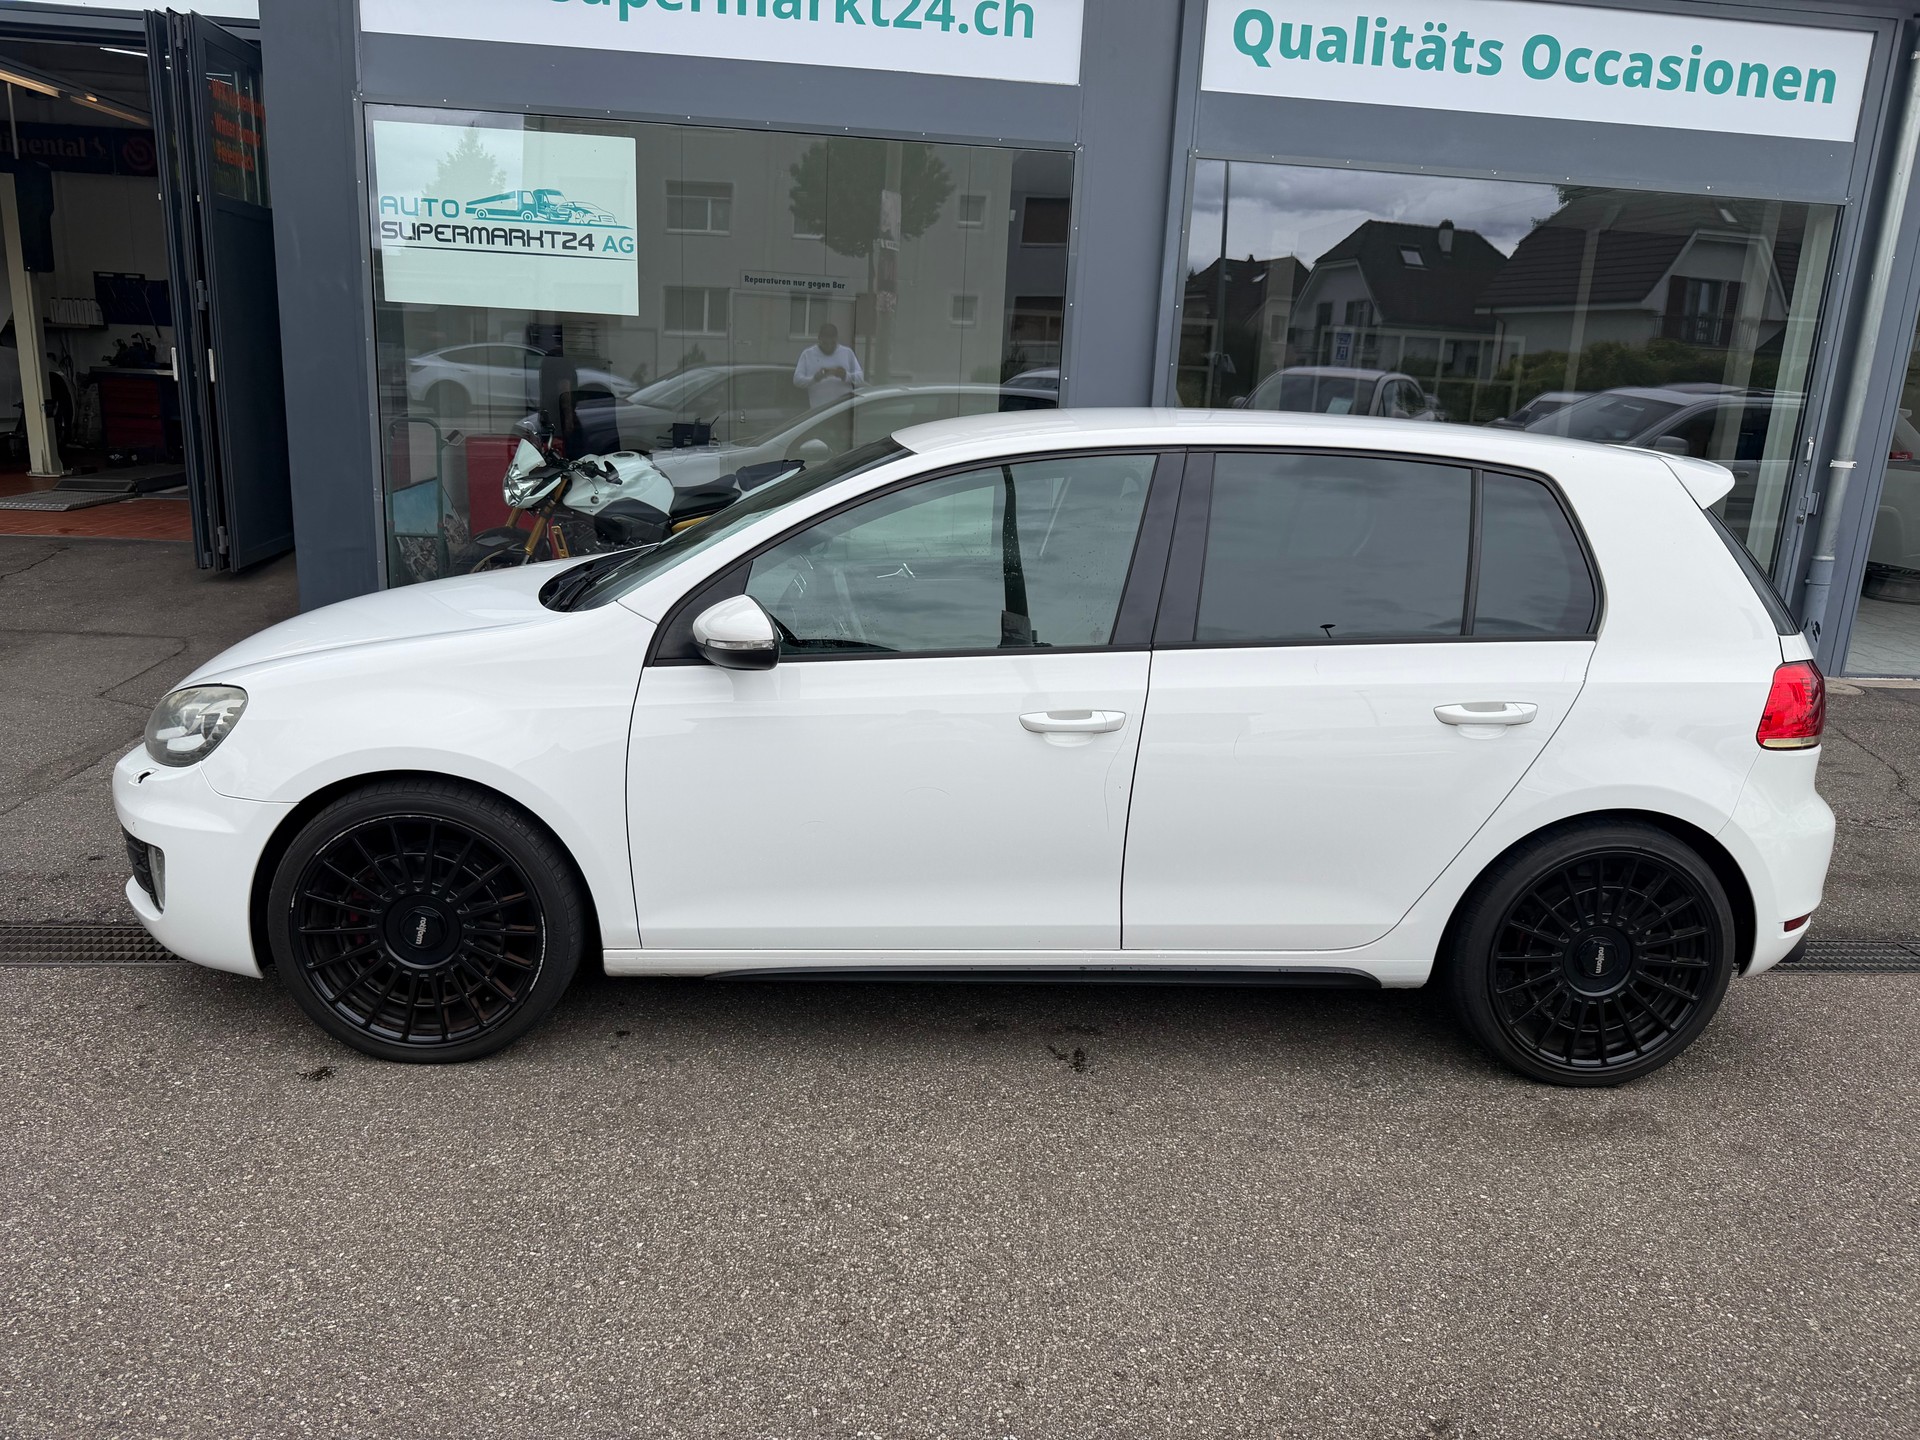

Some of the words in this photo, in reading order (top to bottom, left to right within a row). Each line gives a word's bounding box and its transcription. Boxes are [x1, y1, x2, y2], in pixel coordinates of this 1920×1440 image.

[1234, 8, 1505, 77] Qualitäts
[1521, 33, 1837, 104] Occasionen
[380, 195, 460, 219] AUTO
[380, 220, 595, 252] SUPERMARKT24
[601, 235, 635, 254] AG
[744, 275, 791, 286] Reparaturen
[793, 279, 806, 287] nur
[807, 281, 831, 290] gegen
[832, 281, 846, 289] Bar
